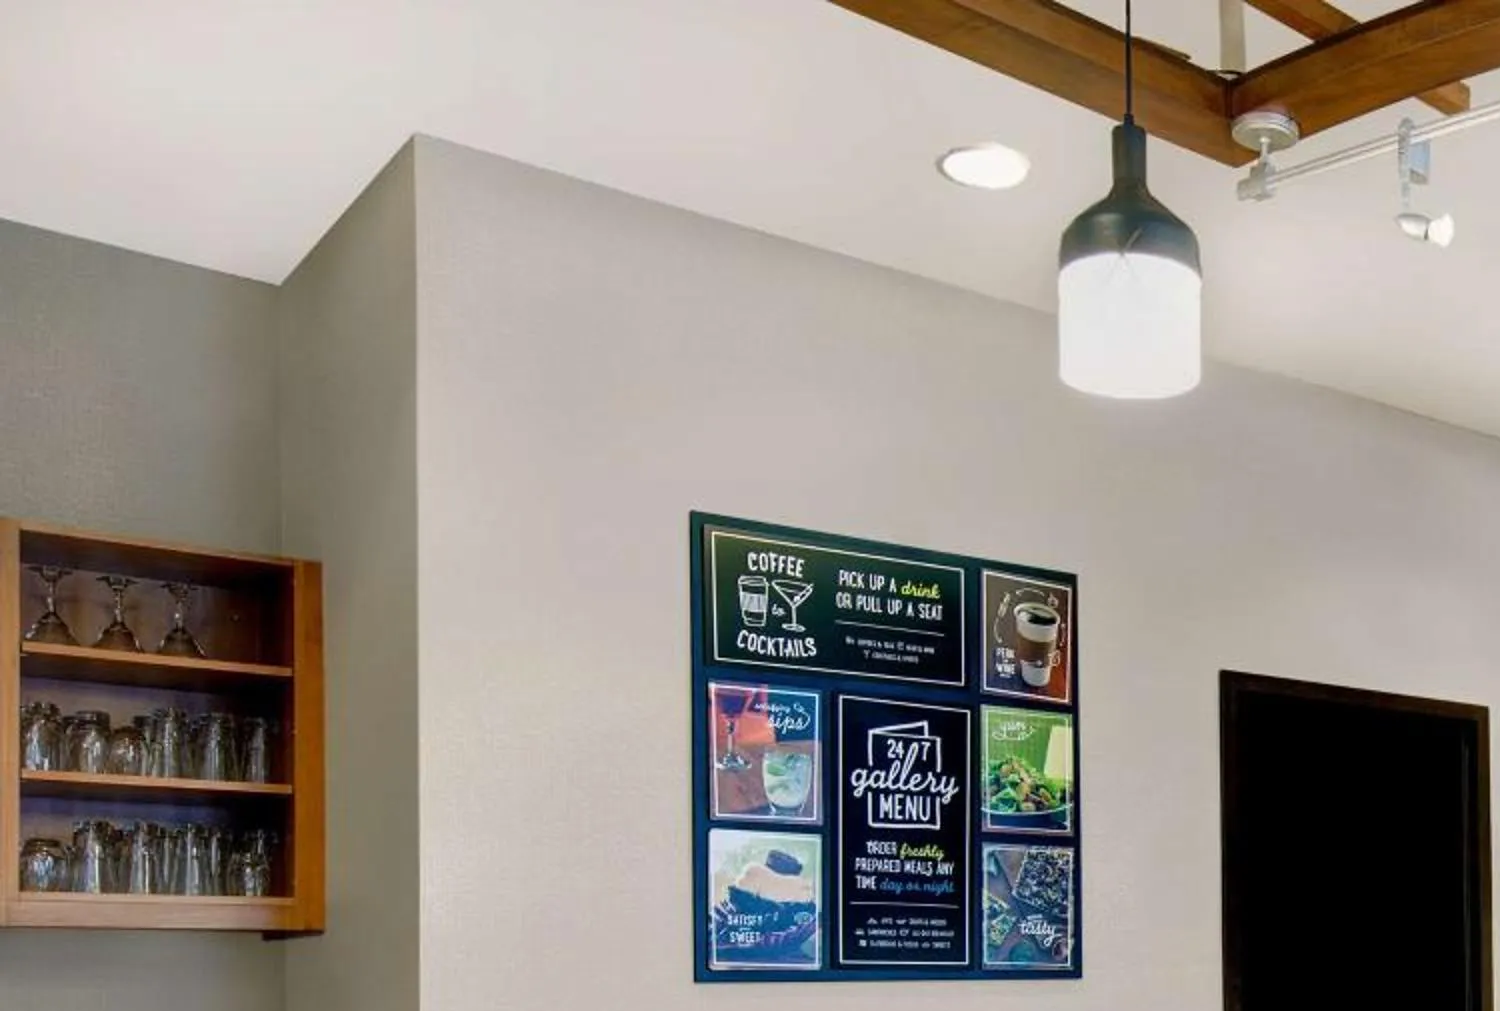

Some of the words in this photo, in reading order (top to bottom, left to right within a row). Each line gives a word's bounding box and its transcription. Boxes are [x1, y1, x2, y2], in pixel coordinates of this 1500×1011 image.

[747, 552, 805, 578] COFFEE
[839, 569, 865, 589] PICK
[869, 573, 885, 591] UP
[889, 578, 897, 593] A
[901, 581, 940, 599] drink
[836, 592, 852, 609] OR
[856, 595, 883, 613] PULL
[887, 599, 903, 615] UP
[906, 602, 915, 617] A
[918, 603, 943, 620] SEAT
[737, 630, 817, 658] COCKTAILS
[851, 742, 959, 805] gallery
[879, 793, 931, 822] MENU
[900, 842, 944, 861] freshly
[855, 857, 901, 873] PREPARED
[904, 861, 933, 877] MEALS
[935, 861, 955, 876] ANY
[855, 875, 877, 890] TIME
